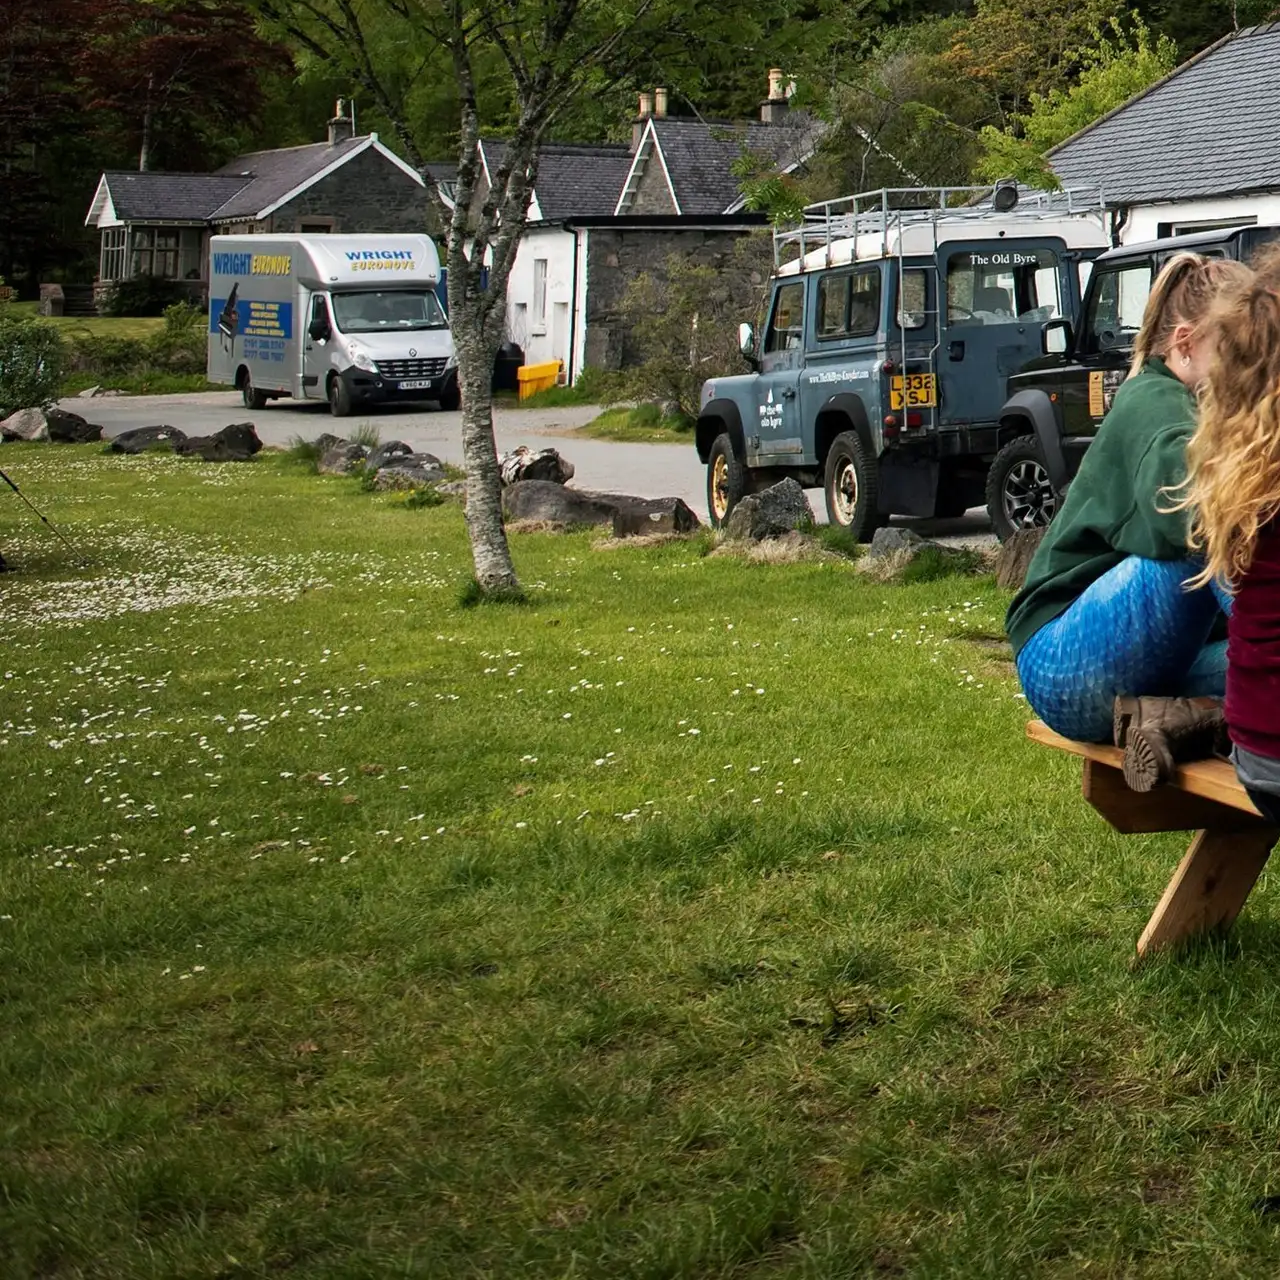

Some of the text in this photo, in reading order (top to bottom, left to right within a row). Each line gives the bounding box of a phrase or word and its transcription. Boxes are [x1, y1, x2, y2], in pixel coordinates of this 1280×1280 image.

[345, 250, 413, 261] WRIGHT
[969, 253, 1036, 266] The Old Byre
[213, 252, 292, 276] WRIGHT EUROMOVE
[351, 260, 416, 272] EUROMOVE
[898, 390, 930, 405] XSJ
